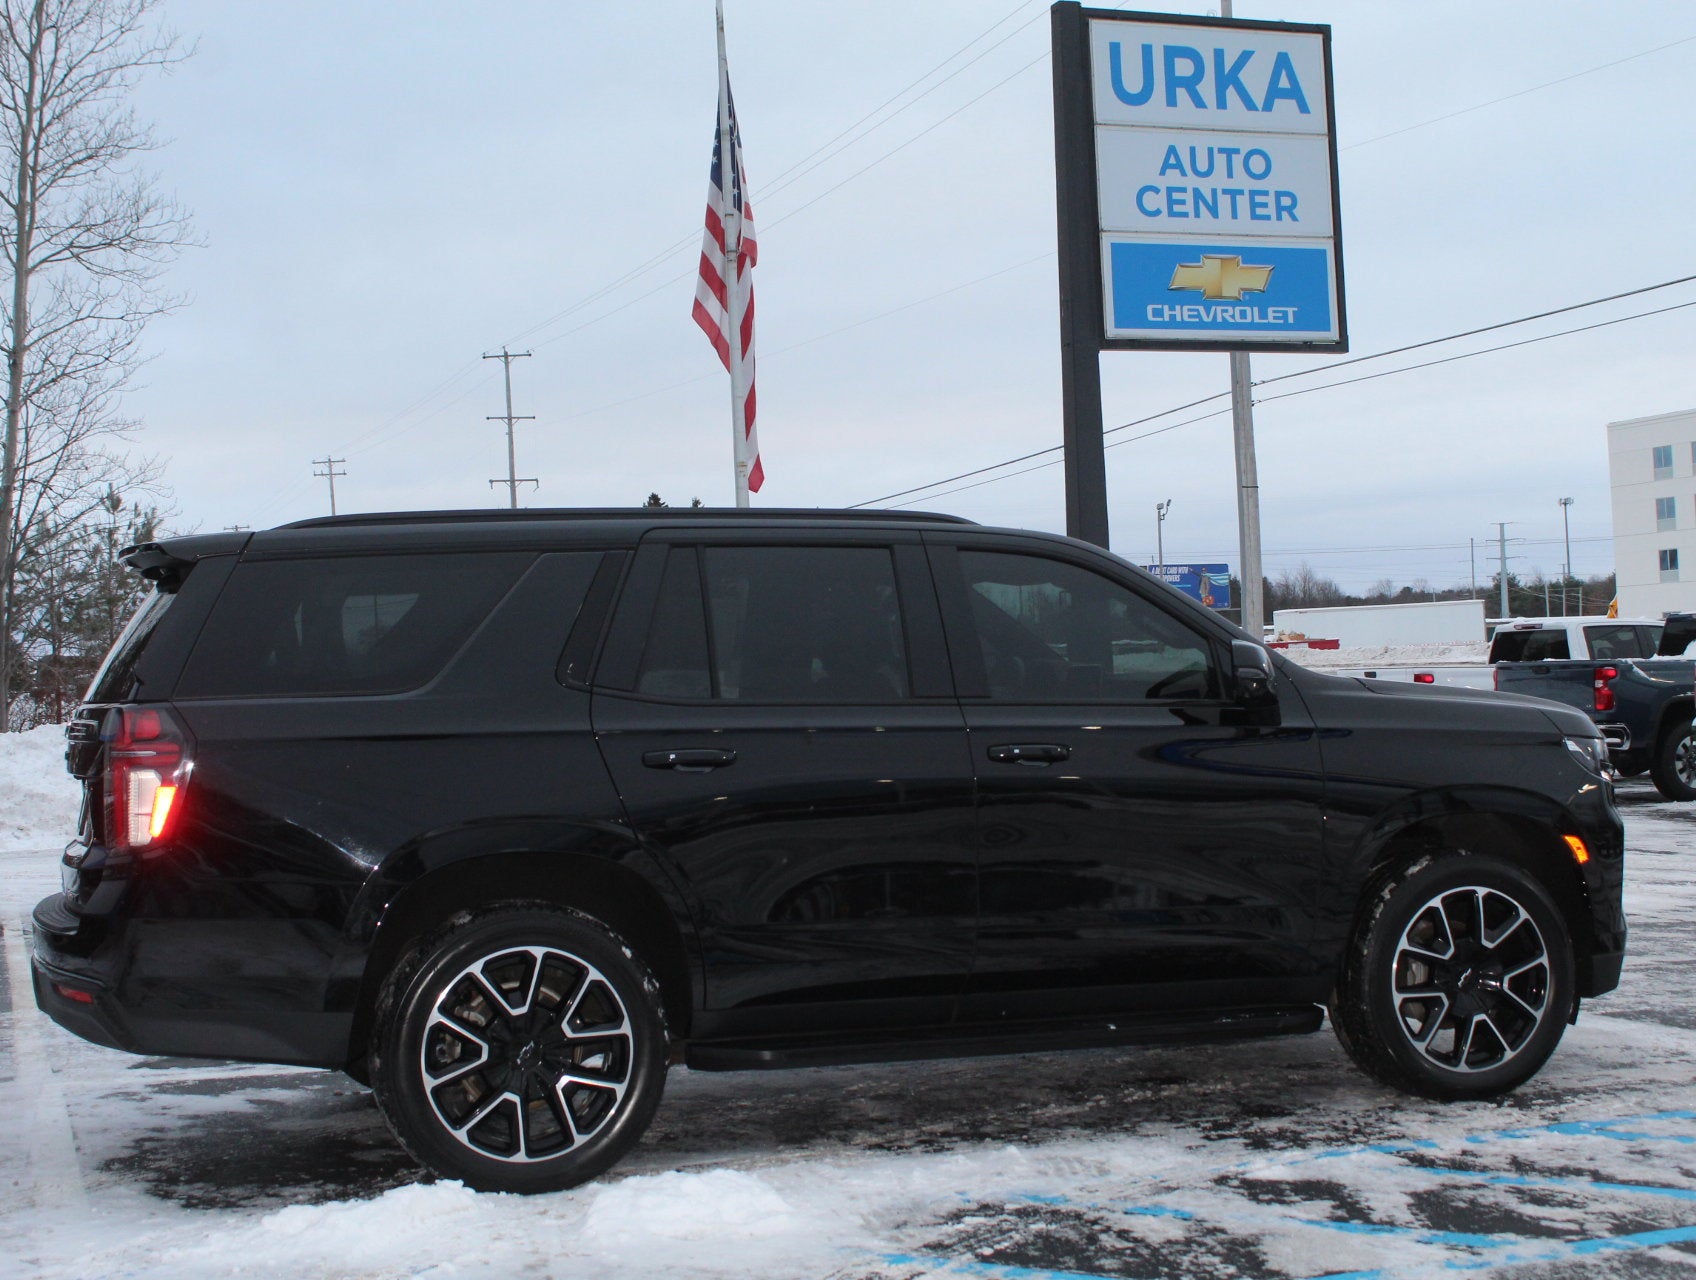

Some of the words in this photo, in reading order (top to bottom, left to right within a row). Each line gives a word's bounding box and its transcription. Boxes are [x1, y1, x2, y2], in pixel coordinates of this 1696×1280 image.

[1109, 41, 1311, 114] URKA
[1159, 144, 1273, 180] AUTO
[1136, 185, 1300, 222] CENTER
[1147, 304, 1298, 323] CHEVROLET
